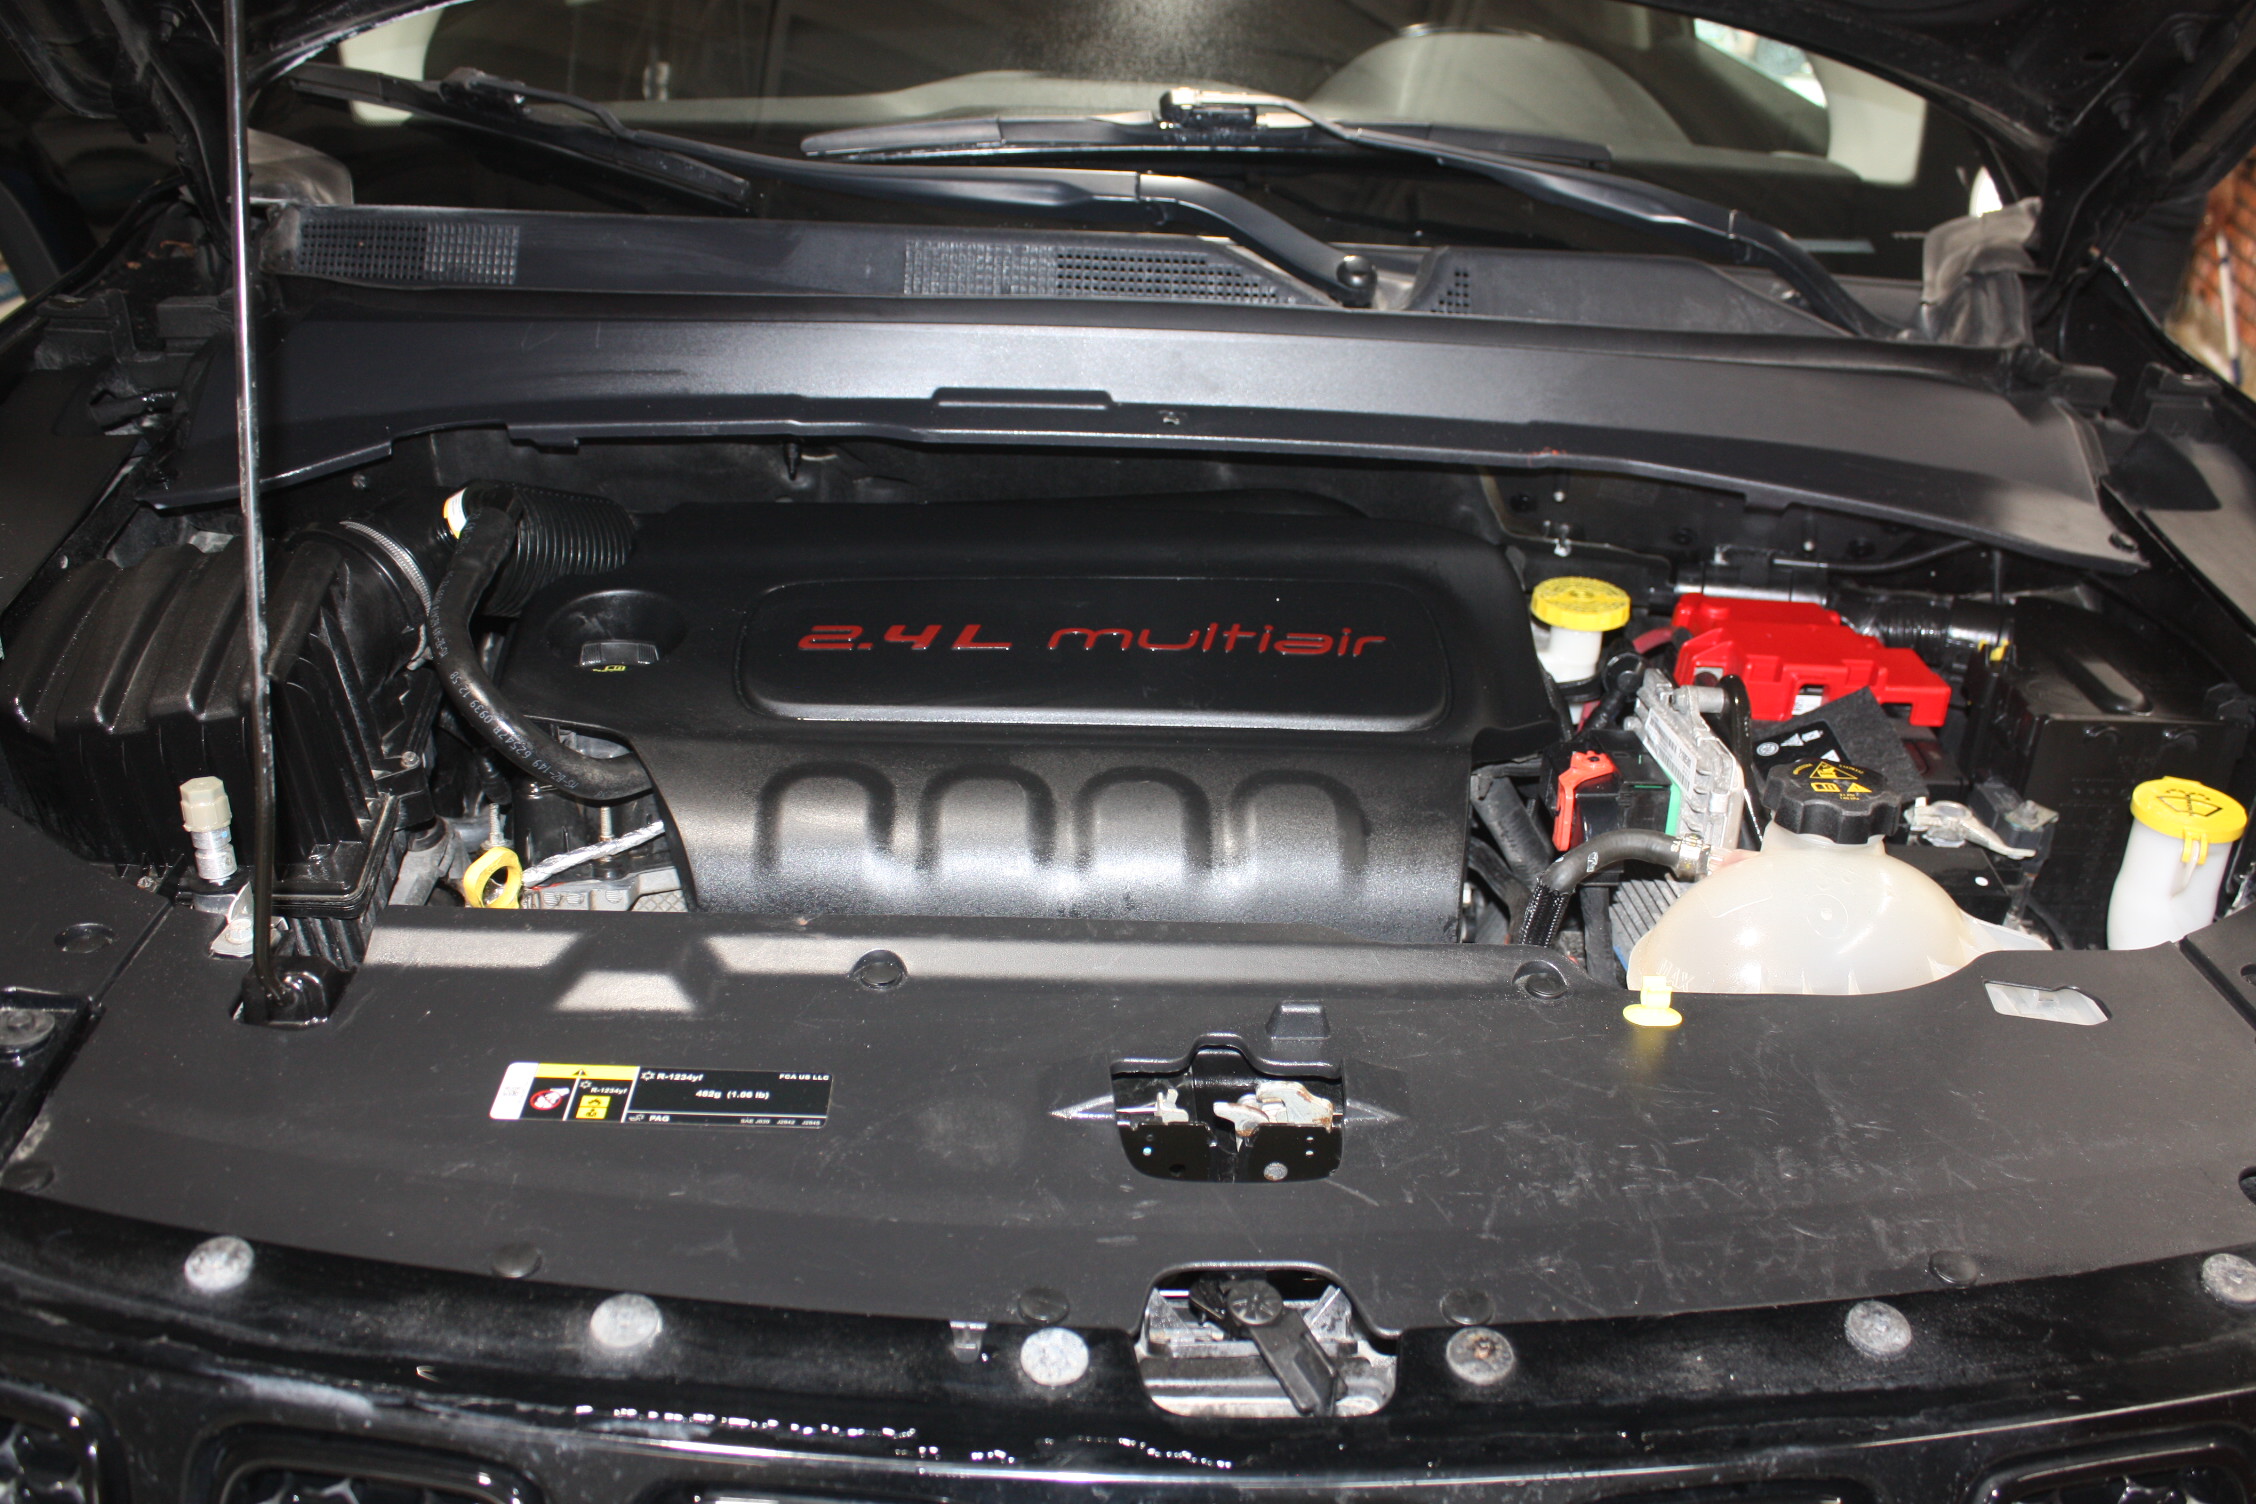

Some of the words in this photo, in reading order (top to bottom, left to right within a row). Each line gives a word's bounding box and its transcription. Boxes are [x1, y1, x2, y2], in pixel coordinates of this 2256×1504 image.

[1047, 623, 1387, 657] multiair
[469, 699, 493, 724] 0939
[656, 1073, 704, 1083] R-1234yf
[591, 1087, 628, 1095] R-1234yf
[755, 1091, 770, 1100] lb)
